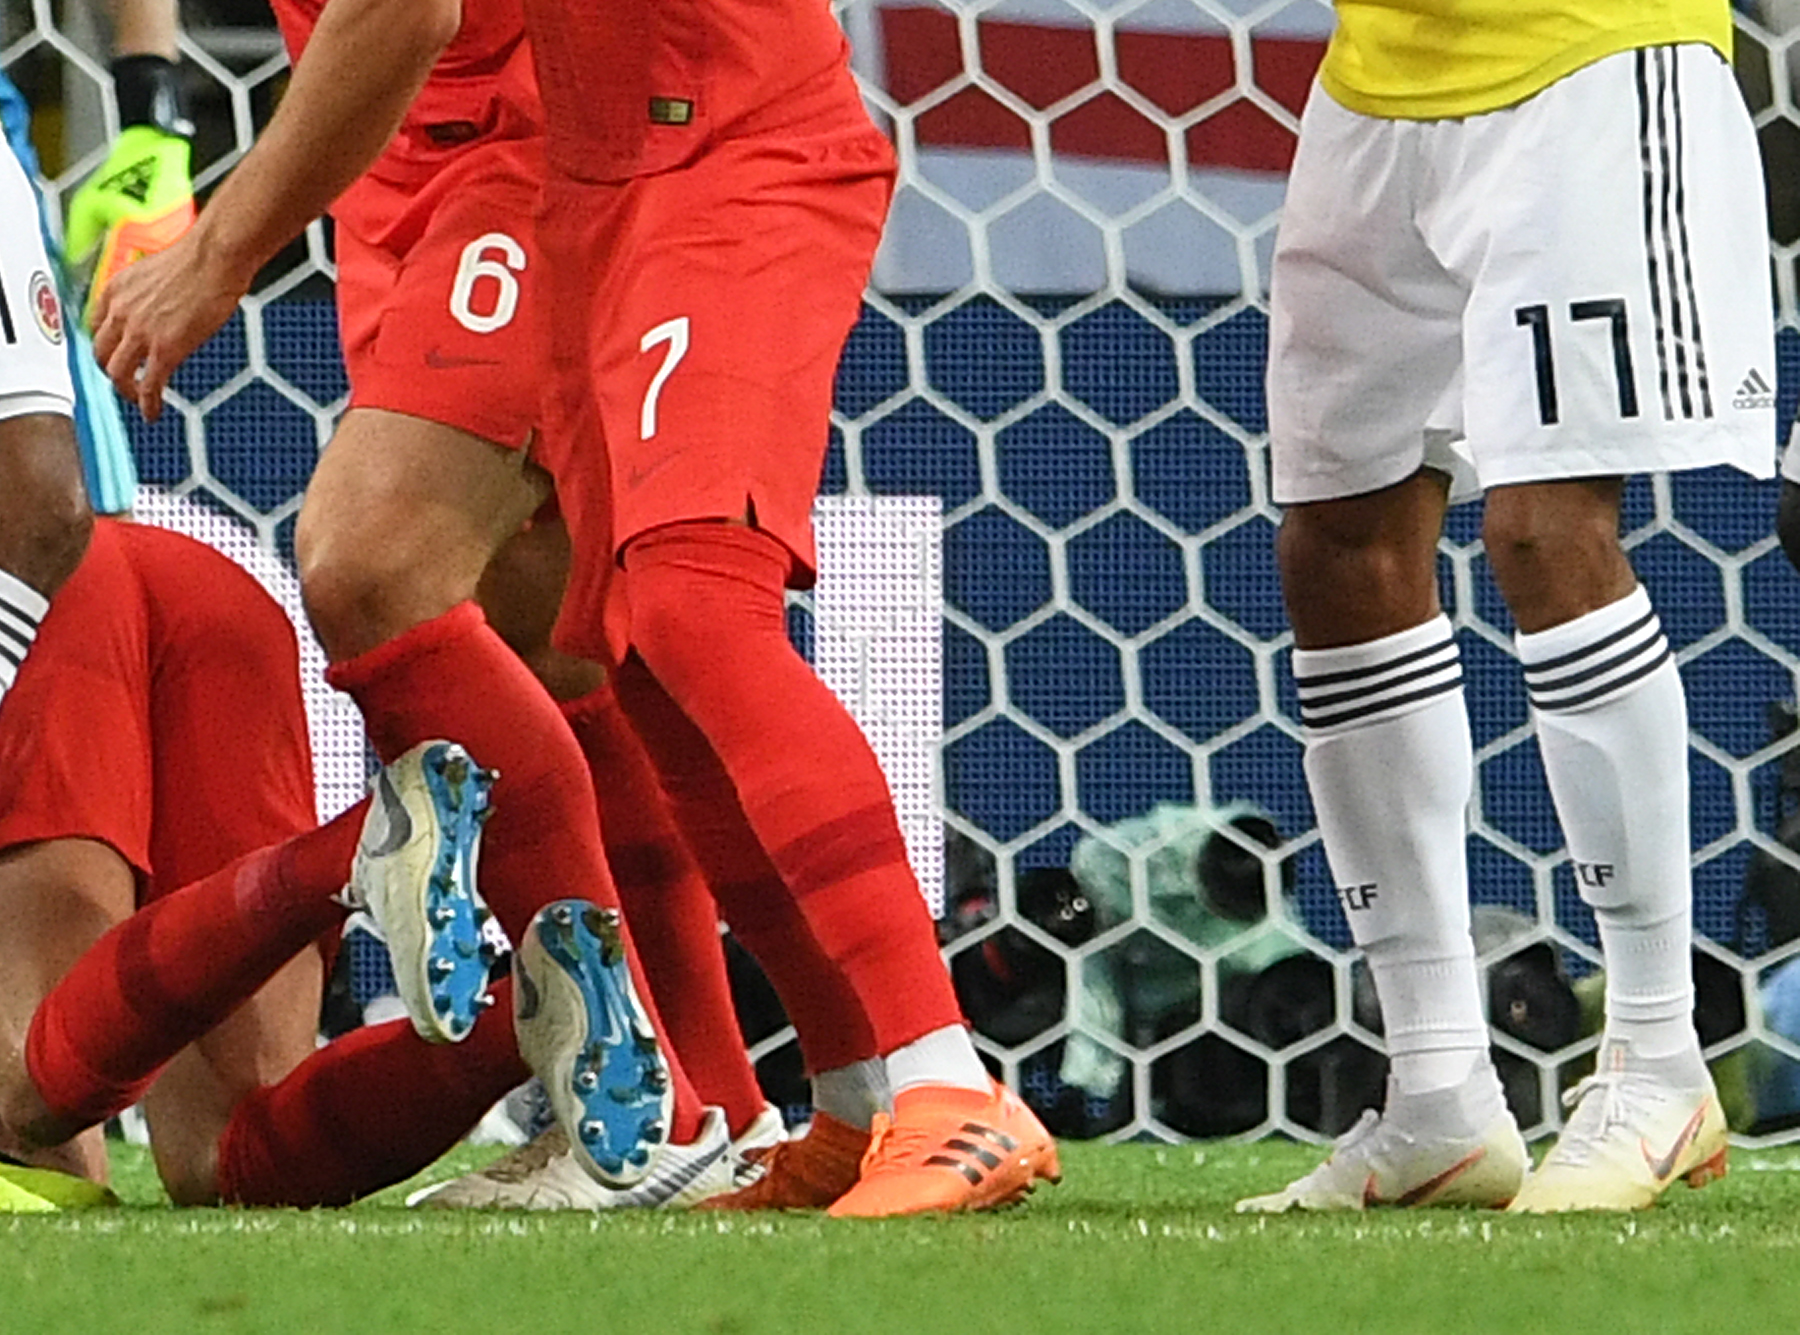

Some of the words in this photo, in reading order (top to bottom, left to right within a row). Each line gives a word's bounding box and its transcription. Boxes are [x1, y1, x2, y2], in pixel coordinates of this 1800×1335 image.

[450, 232, 528, 334] 6
[640, 316, 690, 441] 7
[1514, 297, 1640, 426] 17
